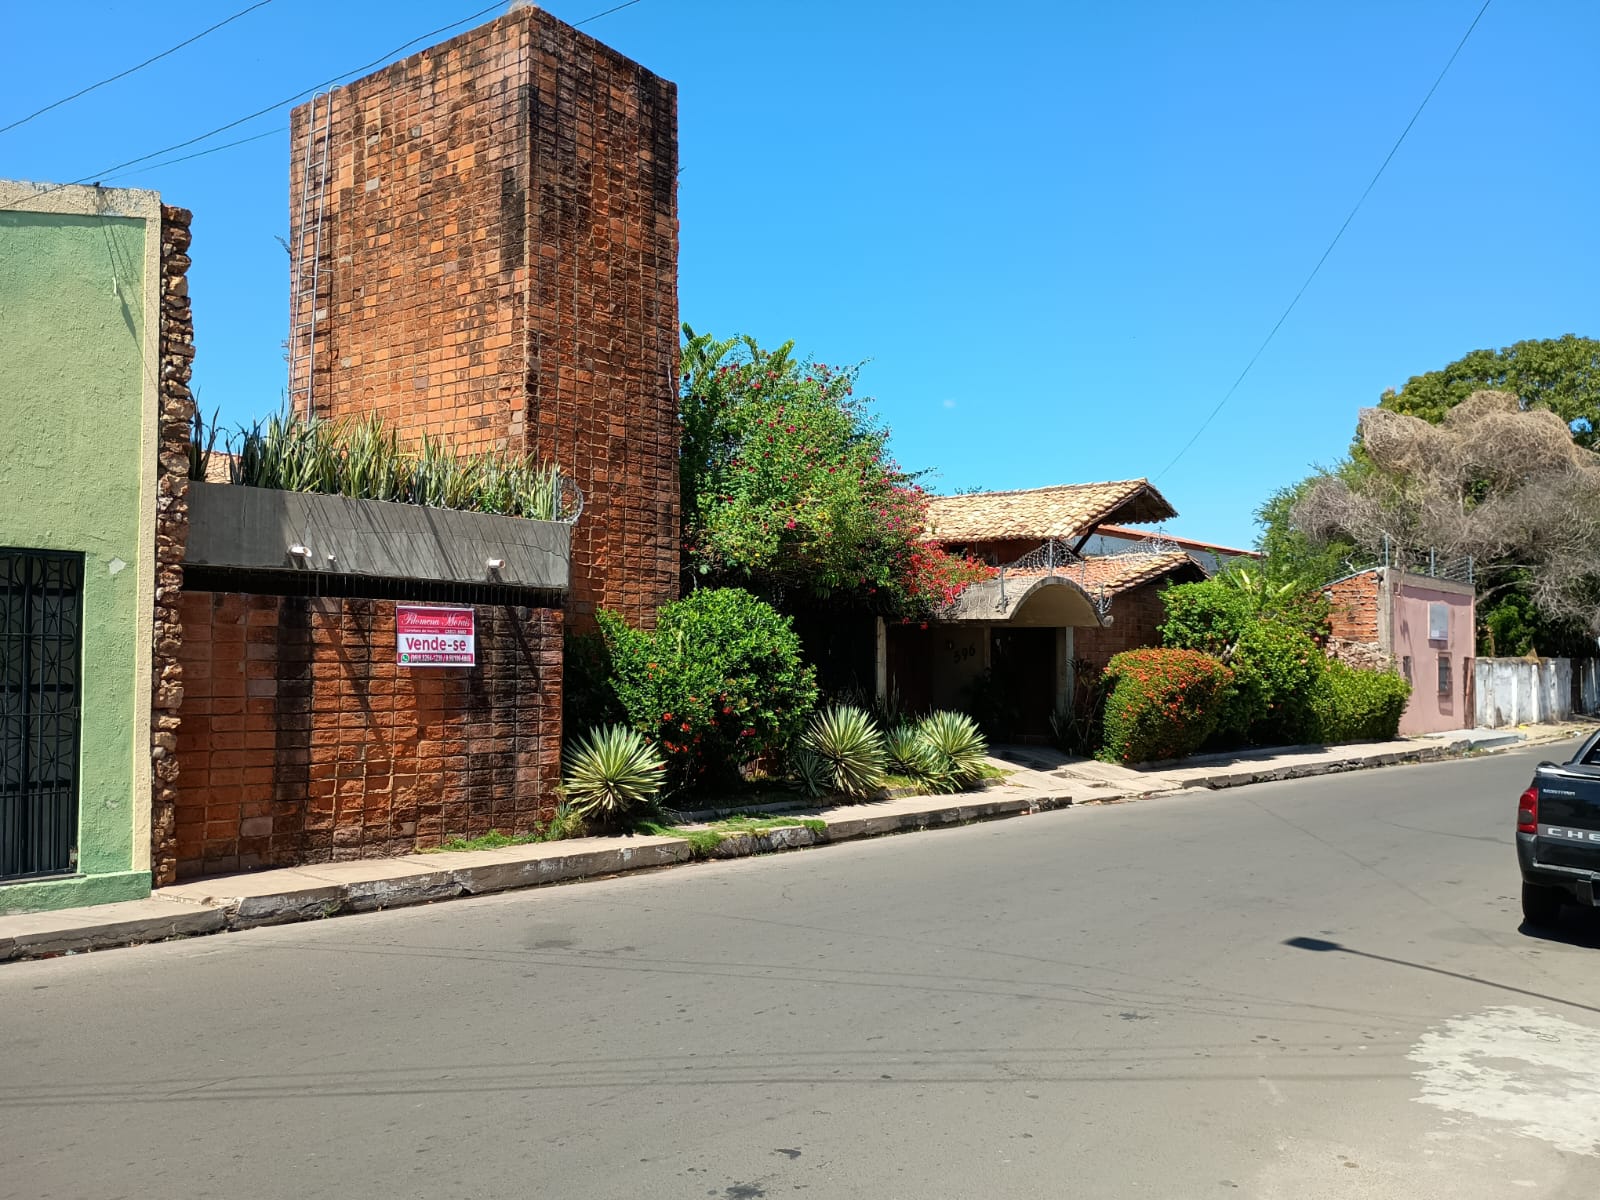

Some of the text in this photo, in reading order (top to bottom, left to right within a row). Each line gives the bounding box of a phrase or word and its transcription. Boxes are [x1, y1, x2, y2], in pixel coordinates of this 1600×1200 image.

[440, 612, 470, 627] Morais
[405, 636, 467, 651] Vende-se
[953, 642, 976, 664] 596
